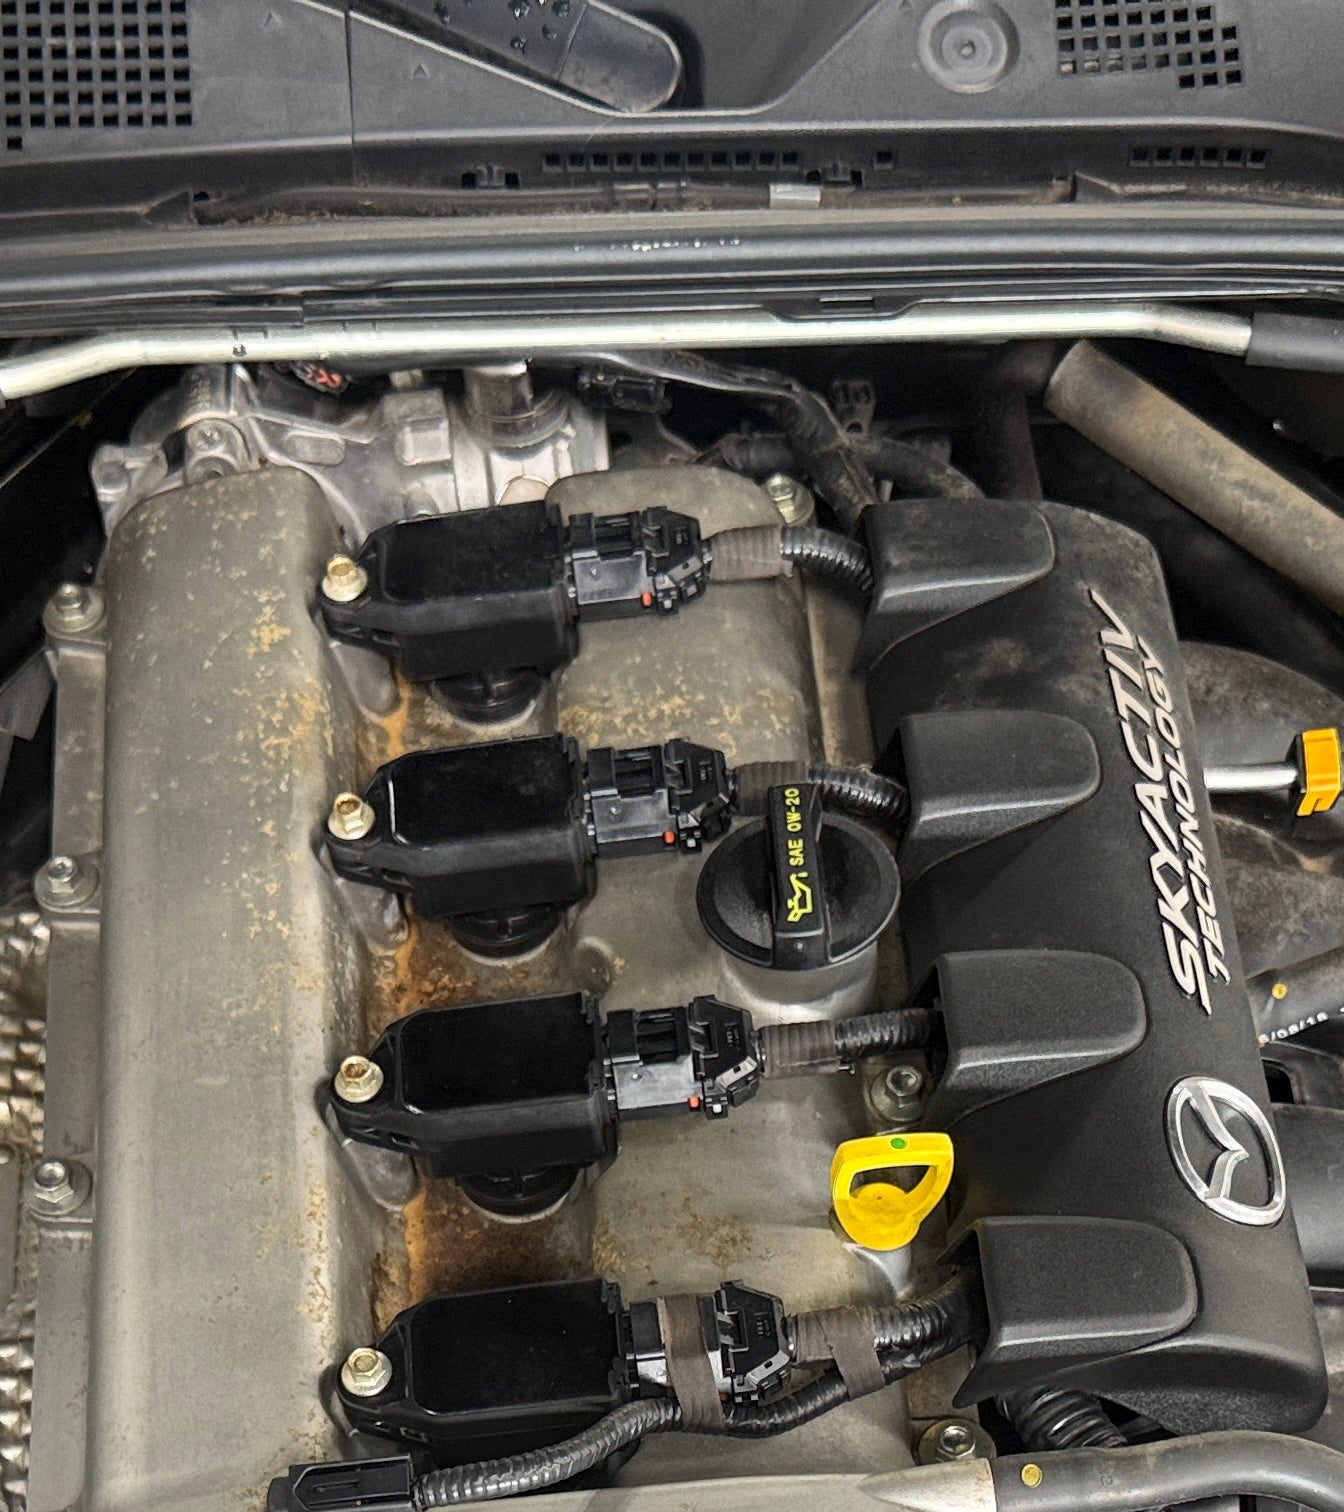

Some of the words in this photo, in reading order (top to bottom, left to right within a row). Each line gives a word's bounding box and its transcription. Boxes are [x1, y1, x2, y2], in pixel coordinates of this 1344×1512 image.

[783, 787, 802, 832] 0W-20
[787, 838, 805, 866] SAE
[1088, 588, 1213, 1016] SKYACTIV
[1136, 635, 1231, 985] TECHNOLOGY
